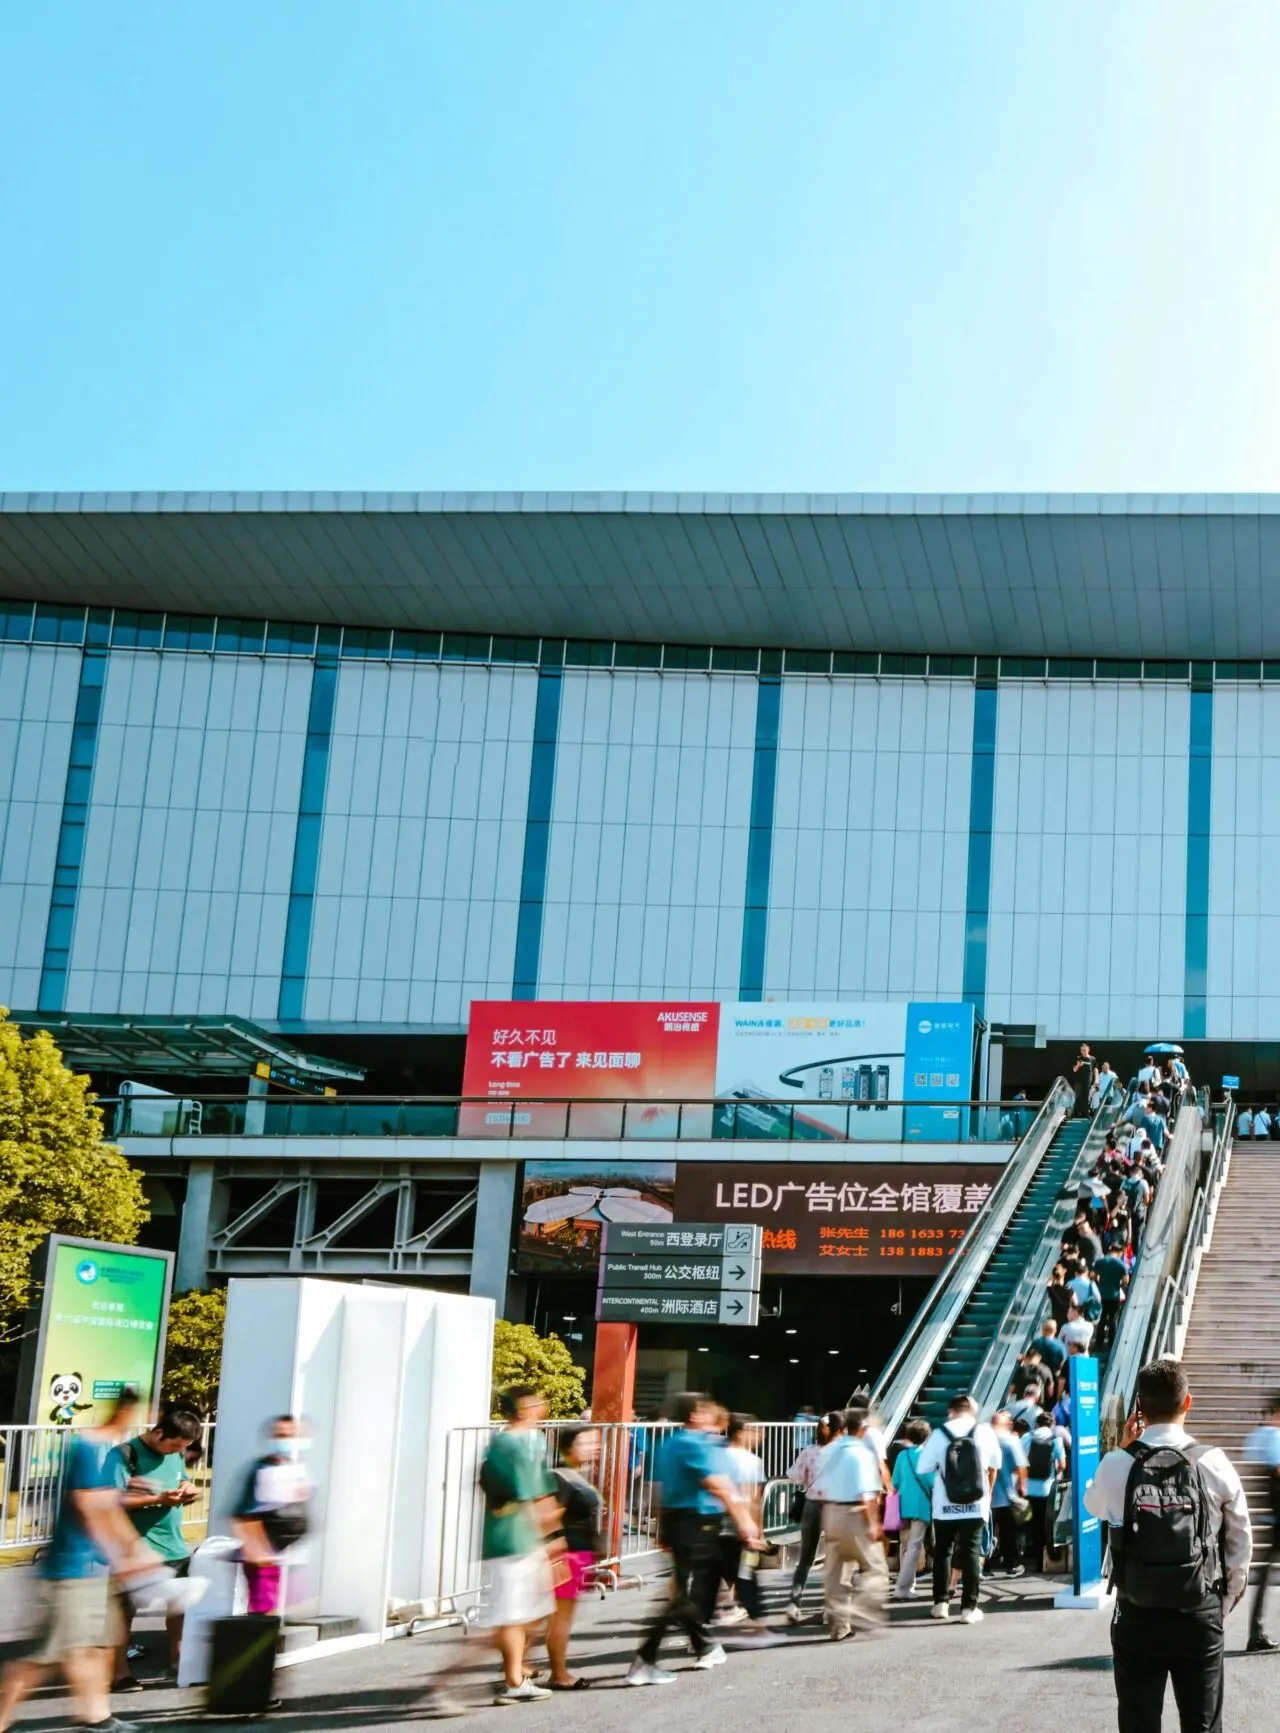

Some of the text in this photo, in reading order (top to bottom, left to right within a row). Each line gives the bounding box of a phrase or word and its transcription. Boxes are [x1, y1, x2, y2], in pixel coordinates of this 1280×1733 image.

[657, 1012, 708, 1022] AKUSENSE
[492, 1029, 557, 1046] 好久不见
[490, 1051, 641, 1068] 不看广告了 来见面聊
[715, 1182, 994, 1213] LED广告位全馆覆盖
[666, 1232, 723, 1247] 西登录厅
[819, 1227, 869, 1239] 张先生
[881, 1229, 905, 1239] 186
[911, 1229, 944, 1239] 1633
[819, 1245, 869, 1257] 艾女士
[880, 1247, 905, 1256] 138
[910, 1247, 944, 1256] 1883
[664, 1265, 720, 1280] 公交枢纽
[602, 1297, 659, 1306] INTERCONTINENTAL
[661, 1299, 718, 1315] 洲际酒店
